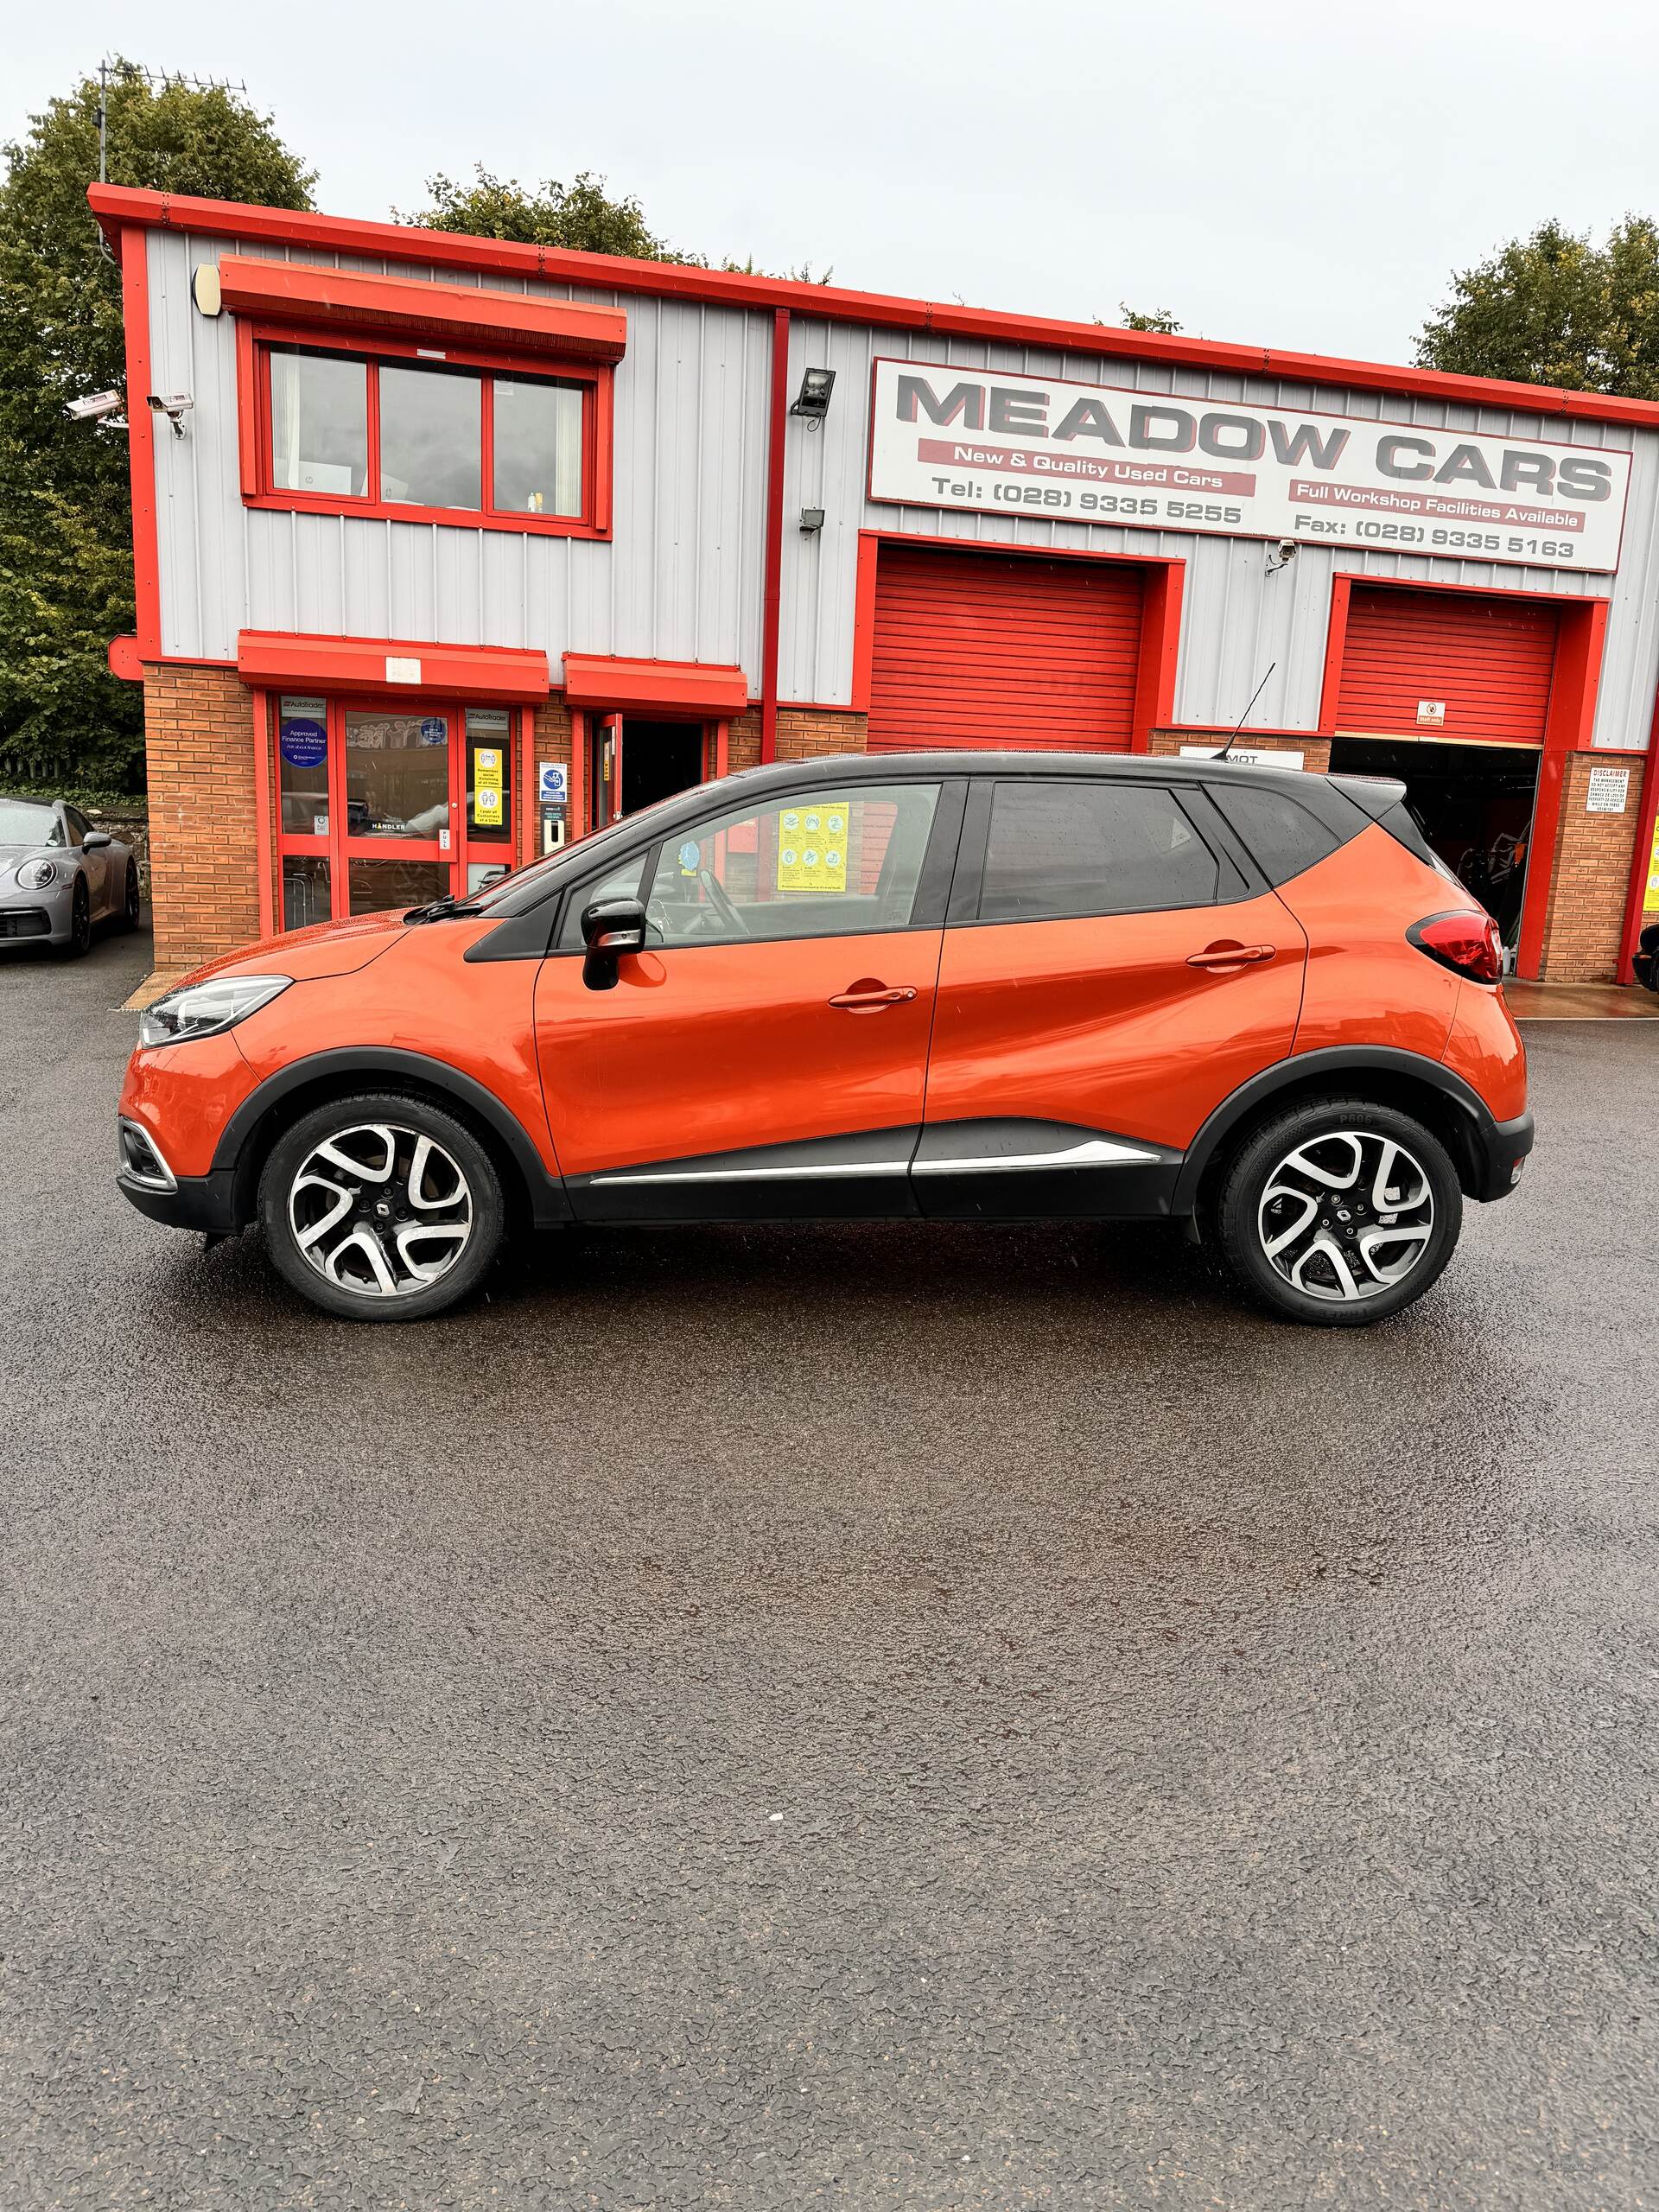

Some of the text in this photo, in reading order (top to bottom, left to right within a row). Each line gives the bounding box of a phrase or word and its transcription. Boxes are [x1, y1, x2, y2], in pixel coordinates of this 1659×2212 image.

[896, 374, 1612, 502] MEADOW CARS
[954, 446, 1224, 488] New & Quality Used Cars
[931, 477, 1242, 524] Tel: (028) 9335 5255
[1297, 483, 1578, 527] Full Workshop Facilities Available
[1294, 514, 1574, 558] Fax: (028) 9335 5163
[1227, 755, 1258, 765] MOT
